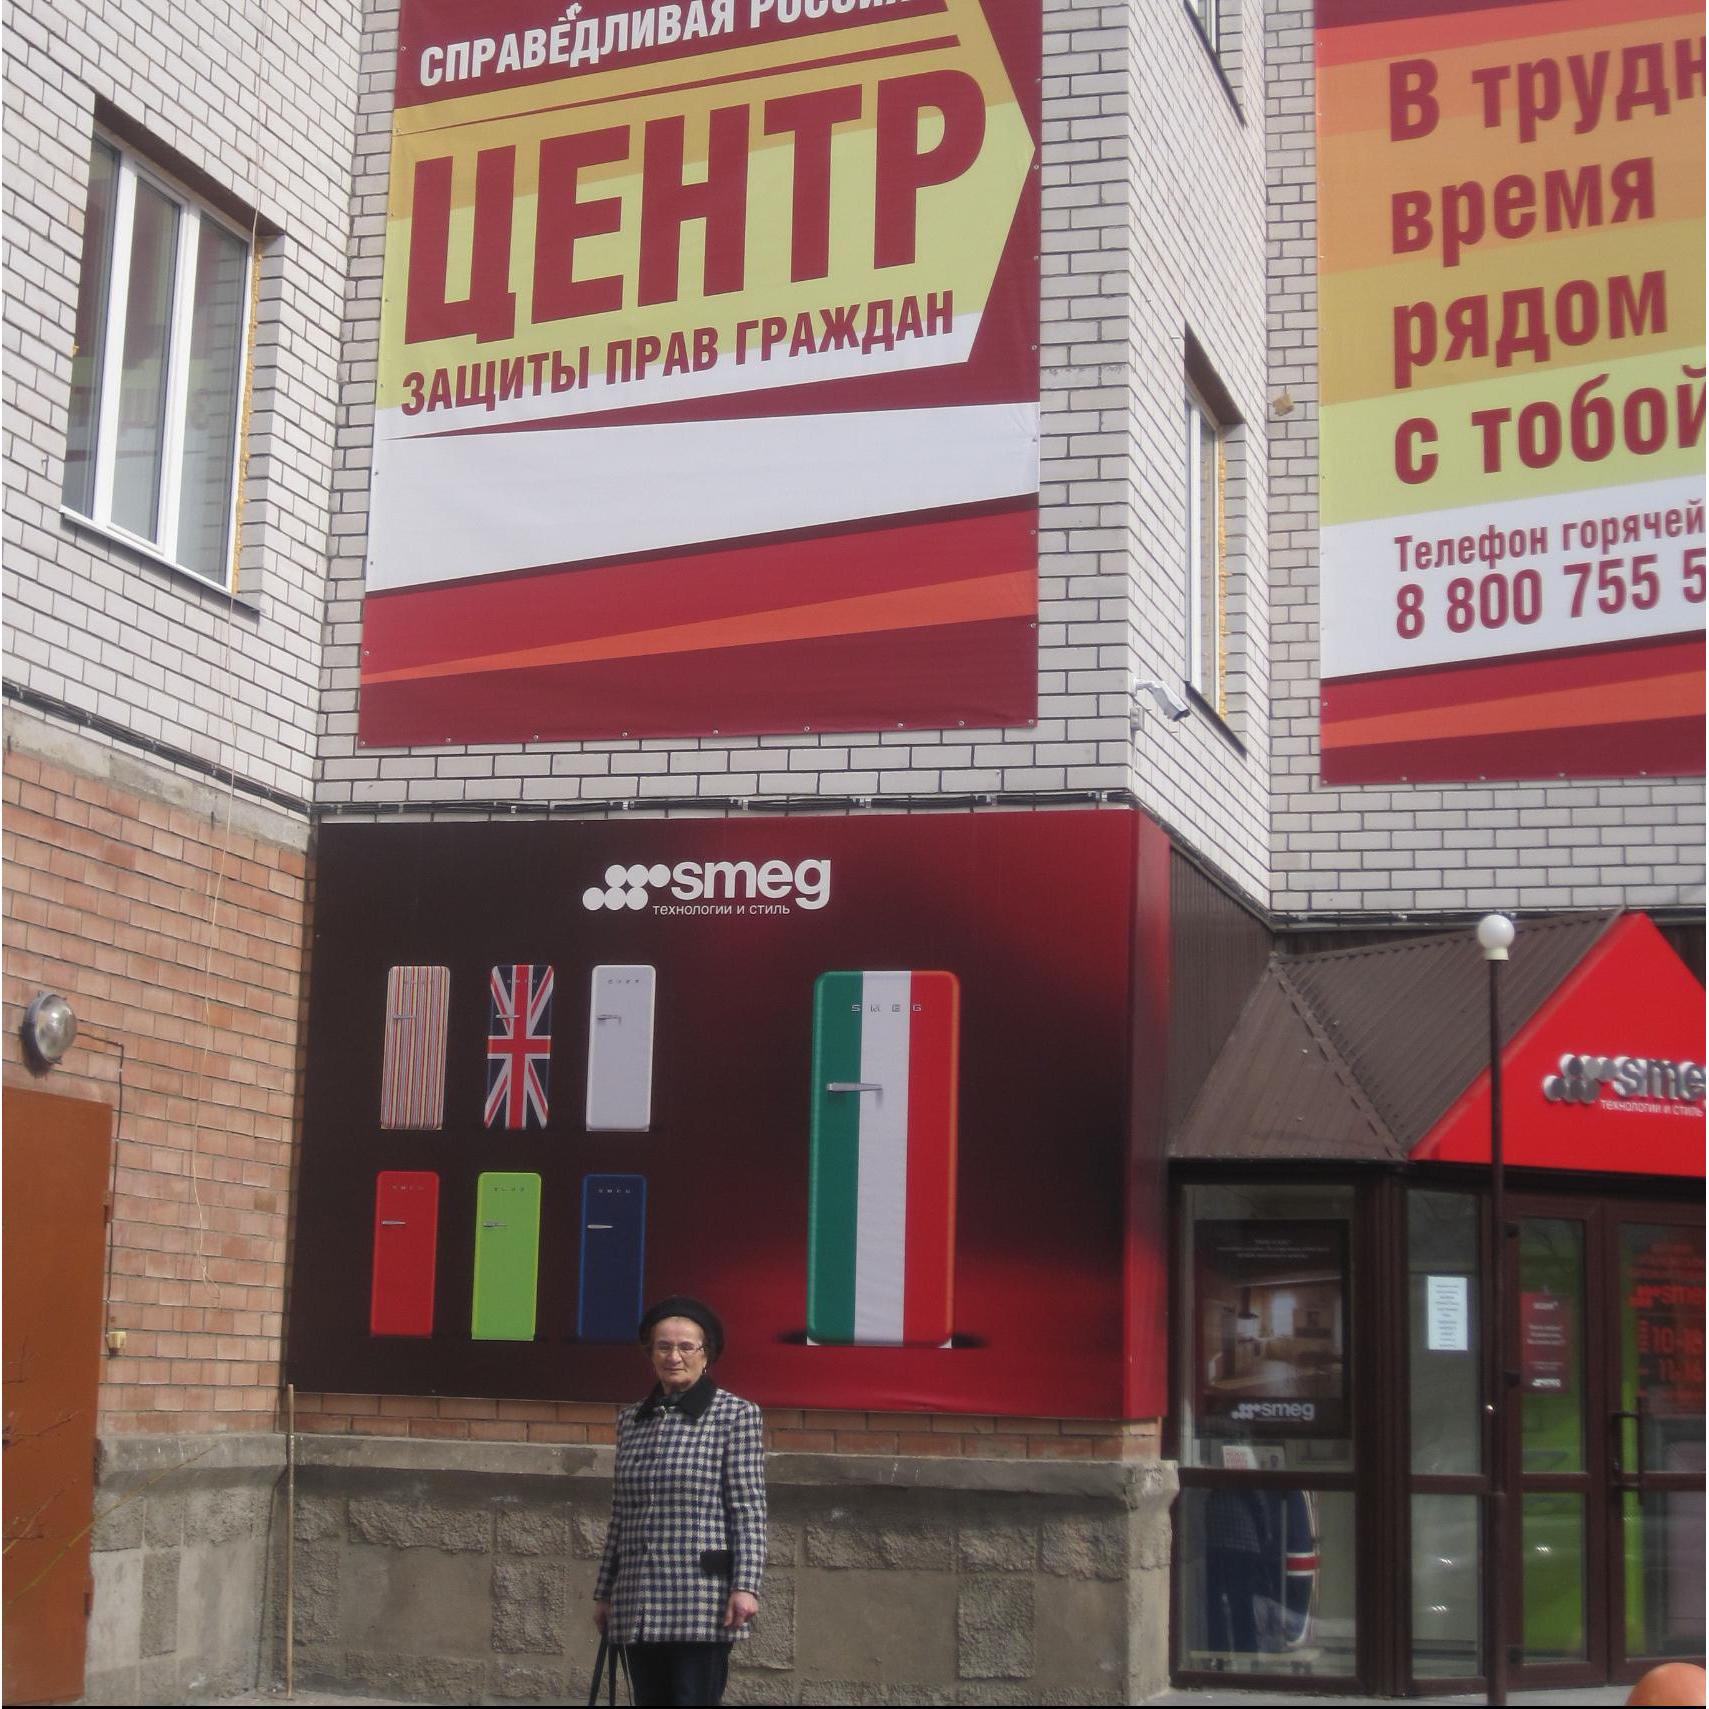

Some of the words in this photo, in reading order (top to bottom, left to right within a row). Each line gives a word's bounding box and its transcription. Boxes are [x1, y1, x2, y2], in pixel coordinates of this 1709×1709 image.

[1389, 58, 1440, 142] В
[404, 69, 987, 345] ЦЕНТР
[1391, 156, 1656, 268] время
[401, 346, 589, 417] ЗАЩИТЫ
[605, 333, 719, 385] ПРАВ
[735, 290, 954, 364] ГРАЖДАН
[1393, 269, 1668, 390] рядом
[1394, 416, 1438, 485] с
[1471, 364, 1706, 474] тобой
[1394, 526, 1549, 574] Телефон
[1562, 498, 1706, 555] горячей
[1395, 583, 1425, 640] 8
[1446, 568, 1542, 635] 800
[1563, 553, 1660, 618] 755
[1683, 547, 1706, 604] 5
[652, 905, 732, 916] технологии
[736, 905, 745, 914] и
[749, 904, 790, 915] стиль
[671, 859, 832, 910] smeg
[1612, 1056, 1706, 1103] sme
[1261, 1402, 1315, 1421] smeg
